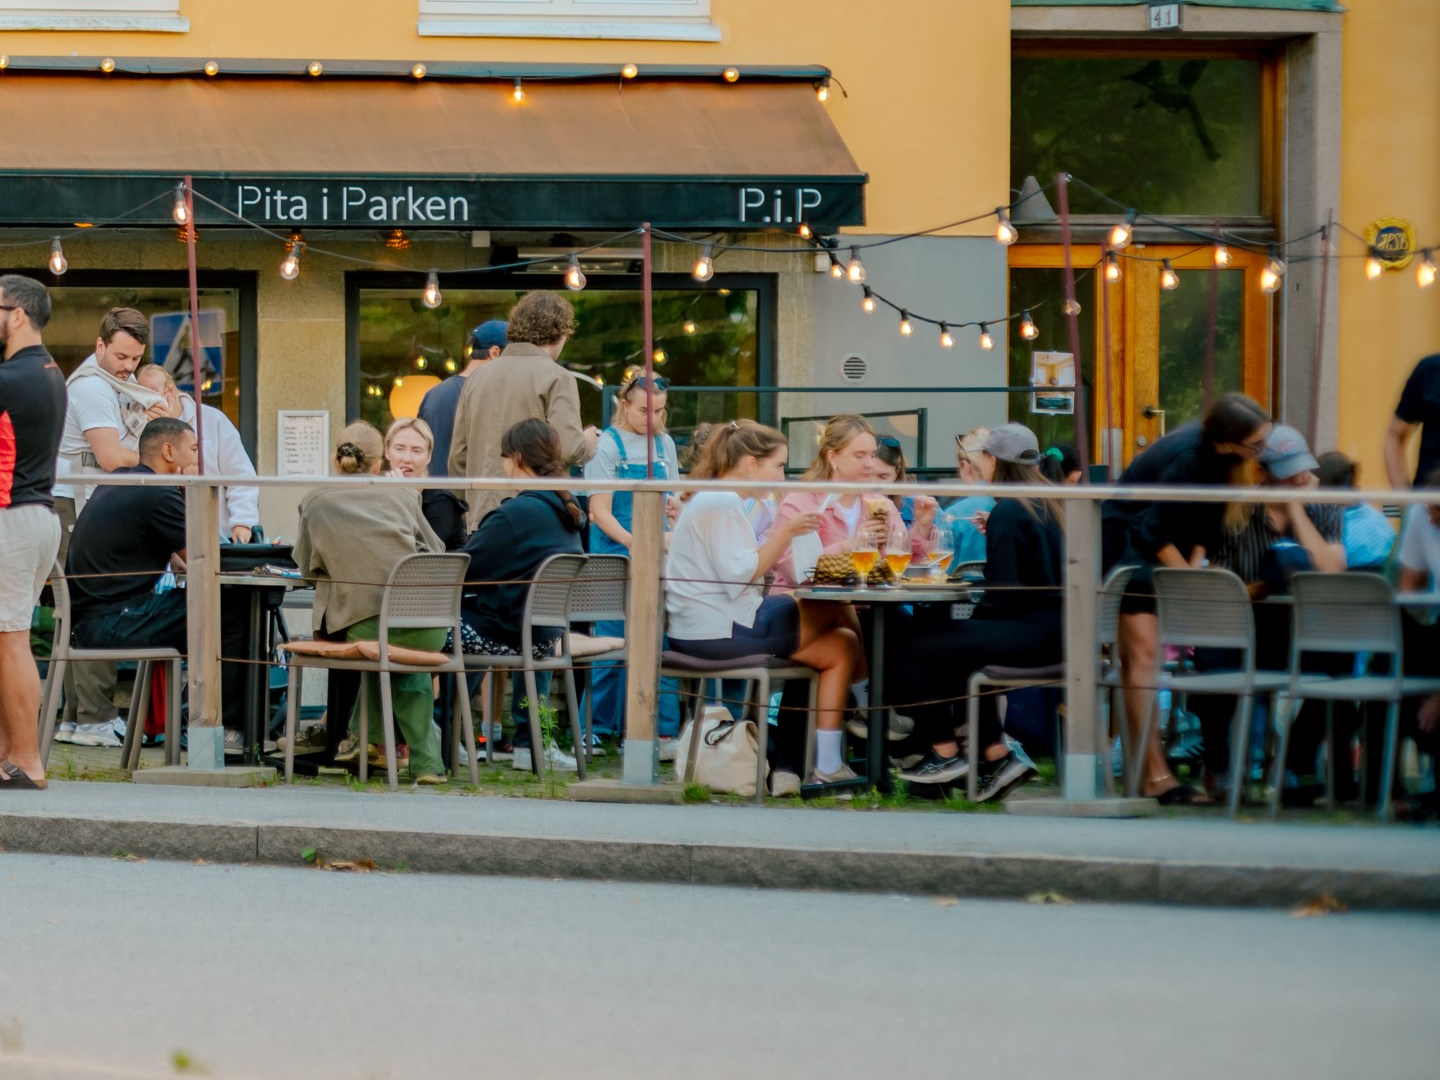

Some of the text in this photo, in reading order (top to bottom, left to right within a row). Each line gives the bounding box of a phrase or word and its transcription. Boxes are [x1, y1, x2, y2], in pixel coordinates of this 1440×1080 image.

[1154, 7, 1172, 27] 41
[238, 185, 469, 221] Pita i Parken
[740, 187, 822, 222] P.i.P
